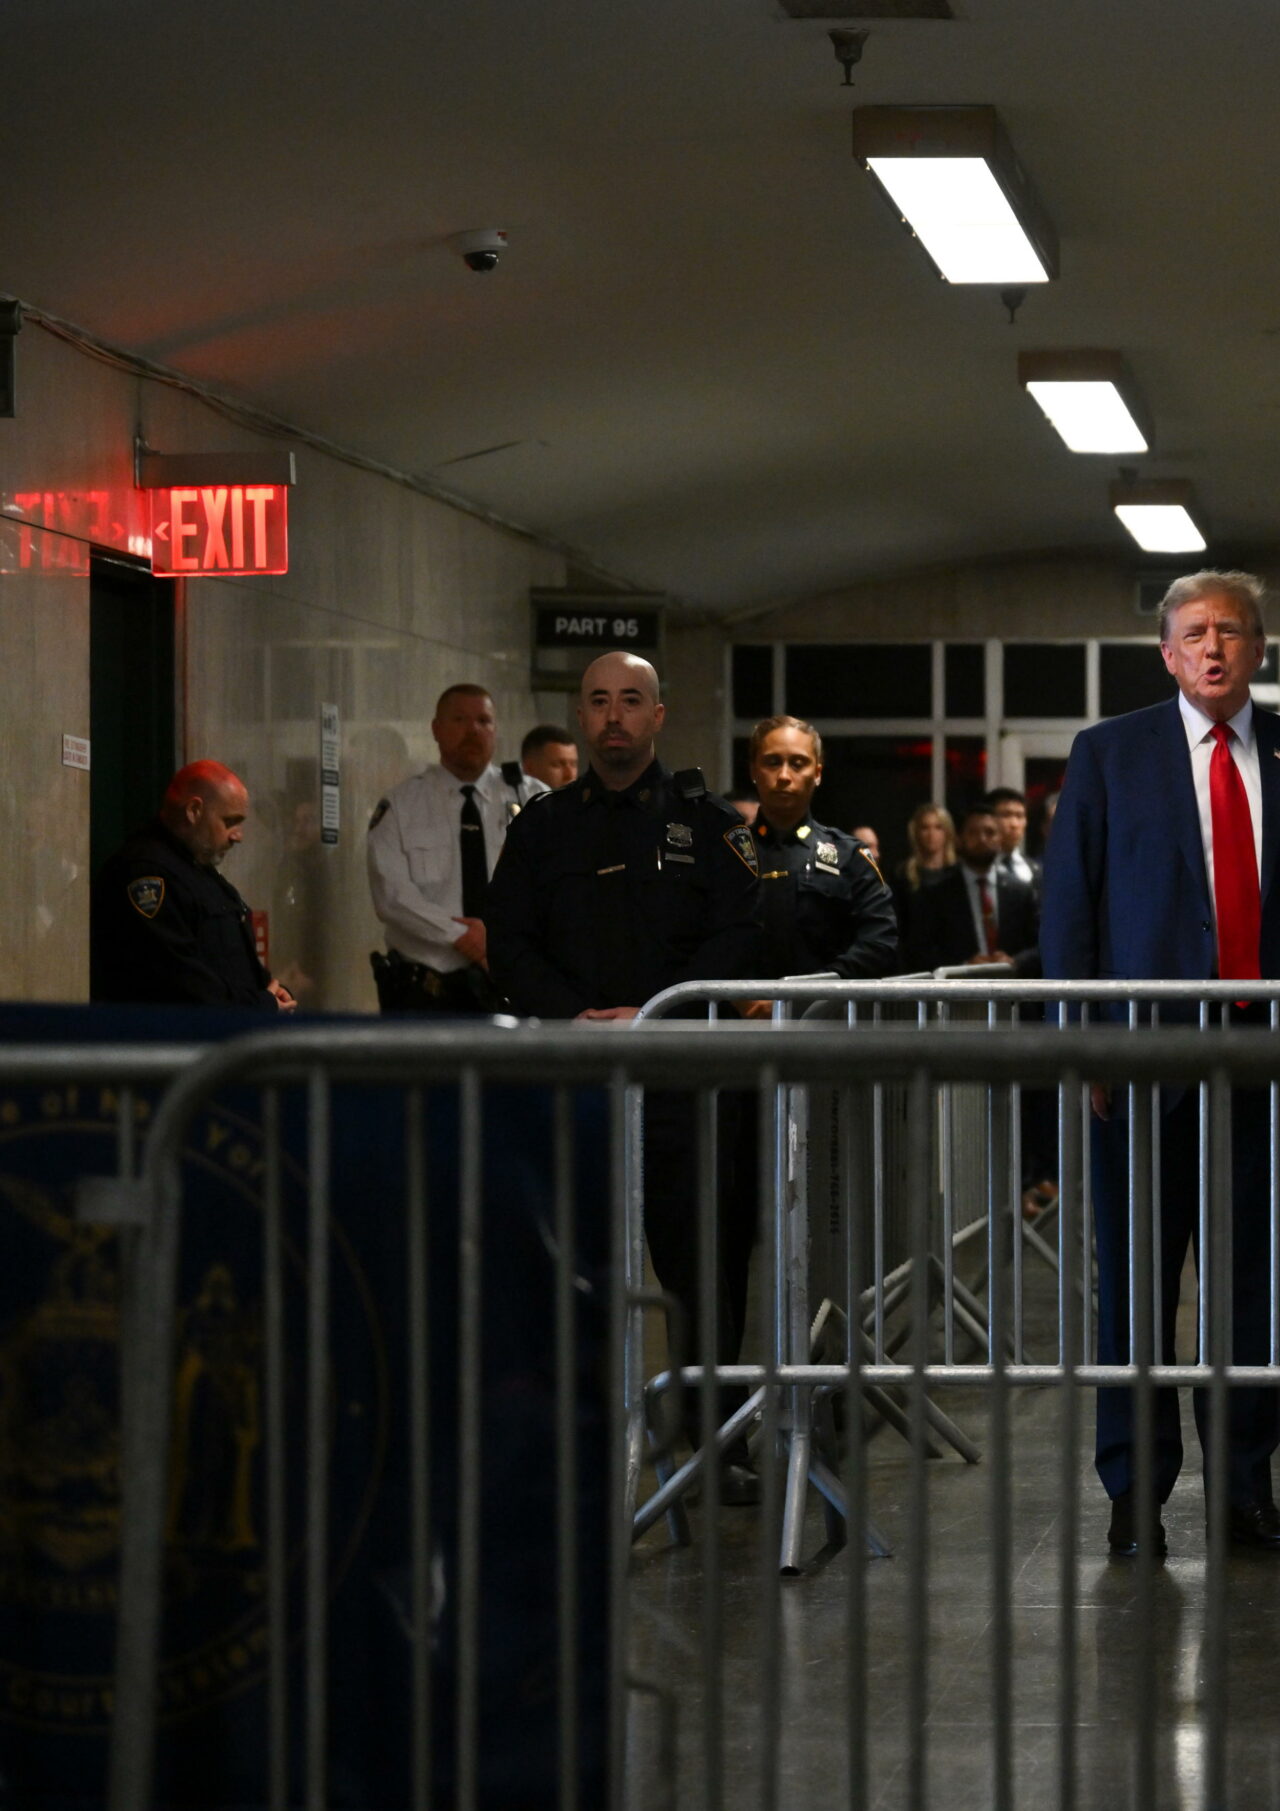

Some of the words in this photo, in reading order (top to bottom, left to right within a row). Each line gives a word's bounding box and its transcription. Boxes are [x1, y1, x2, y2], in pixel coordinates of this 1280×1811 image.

[170, 488, 274, 570] EXIT
[555, 616, 607, 636] PART
[612, 618, 639, 638] 95
